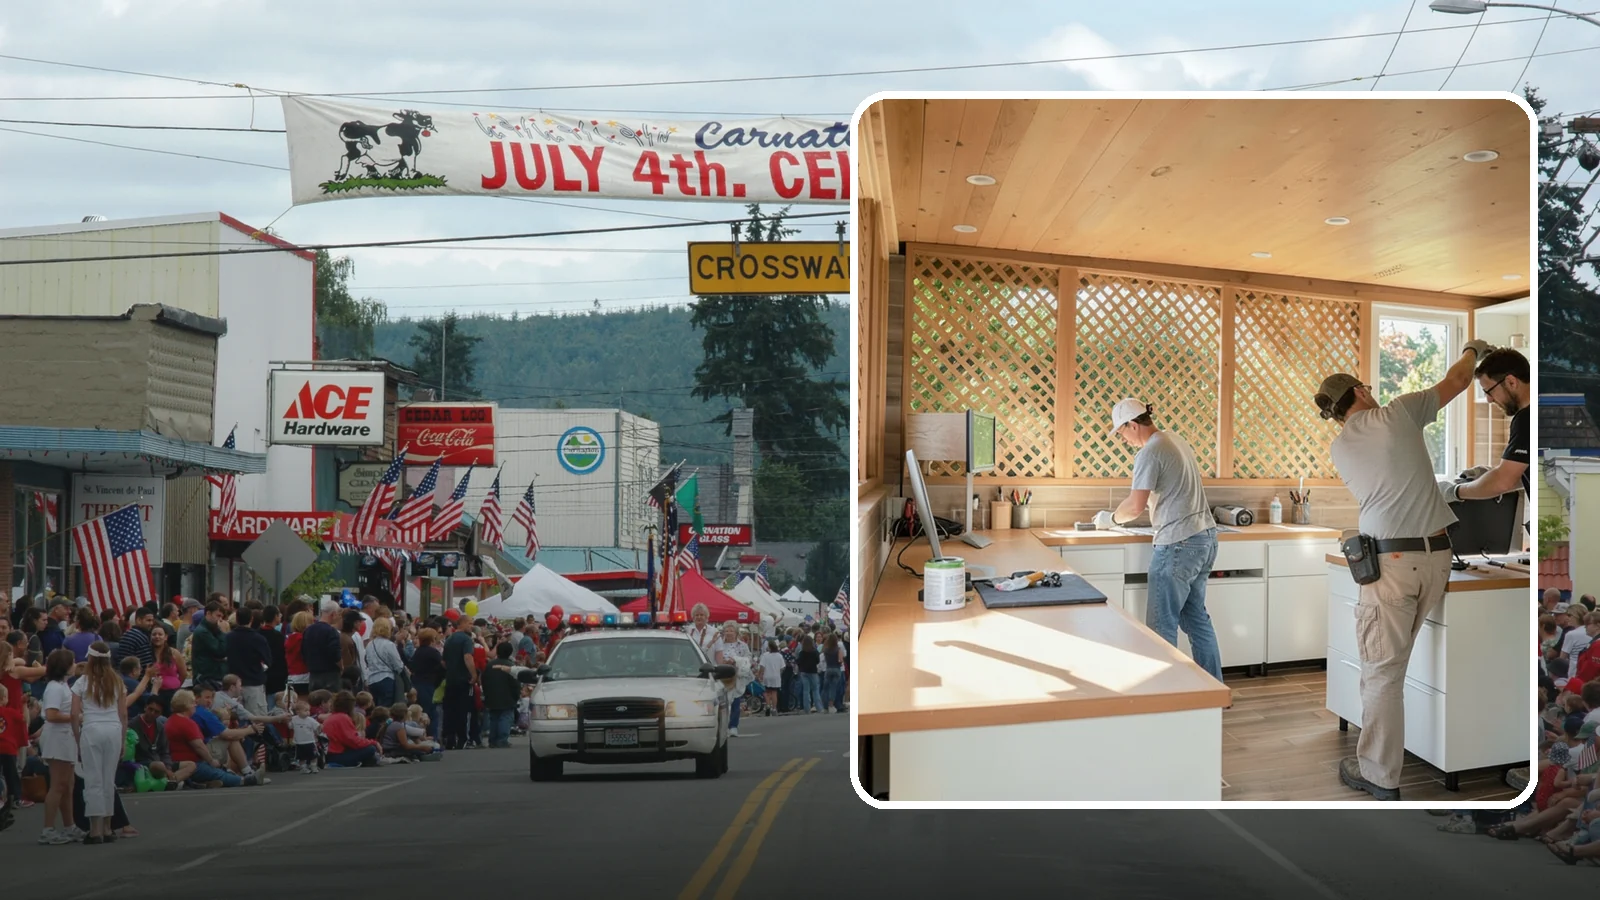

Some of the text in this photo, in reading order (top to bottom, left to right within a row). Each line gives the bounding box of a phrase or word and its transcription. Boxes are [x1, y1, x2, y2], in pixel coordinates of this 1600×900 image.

[481, 141, 604, 192] JULY
[632, 150, 746, 198] 4th.
[697, 254, 850, 280] CROSSWA
[283, 380, 373, 419] ACE
[405, 409, 452, 421] CEDAR
[283, 421, 371, 436] Hardware
[416, 428, 477, 446] Coca-Cola
[354, 467, 385, 480] Simpl
[95, 485, 124, 495] Vincent
[126, 486, 136, 495] de
[137, 486, 155, 495] Paul
[688, 526, 742, 535] CRNATION
[699, 535, 730, 543] GLASS
